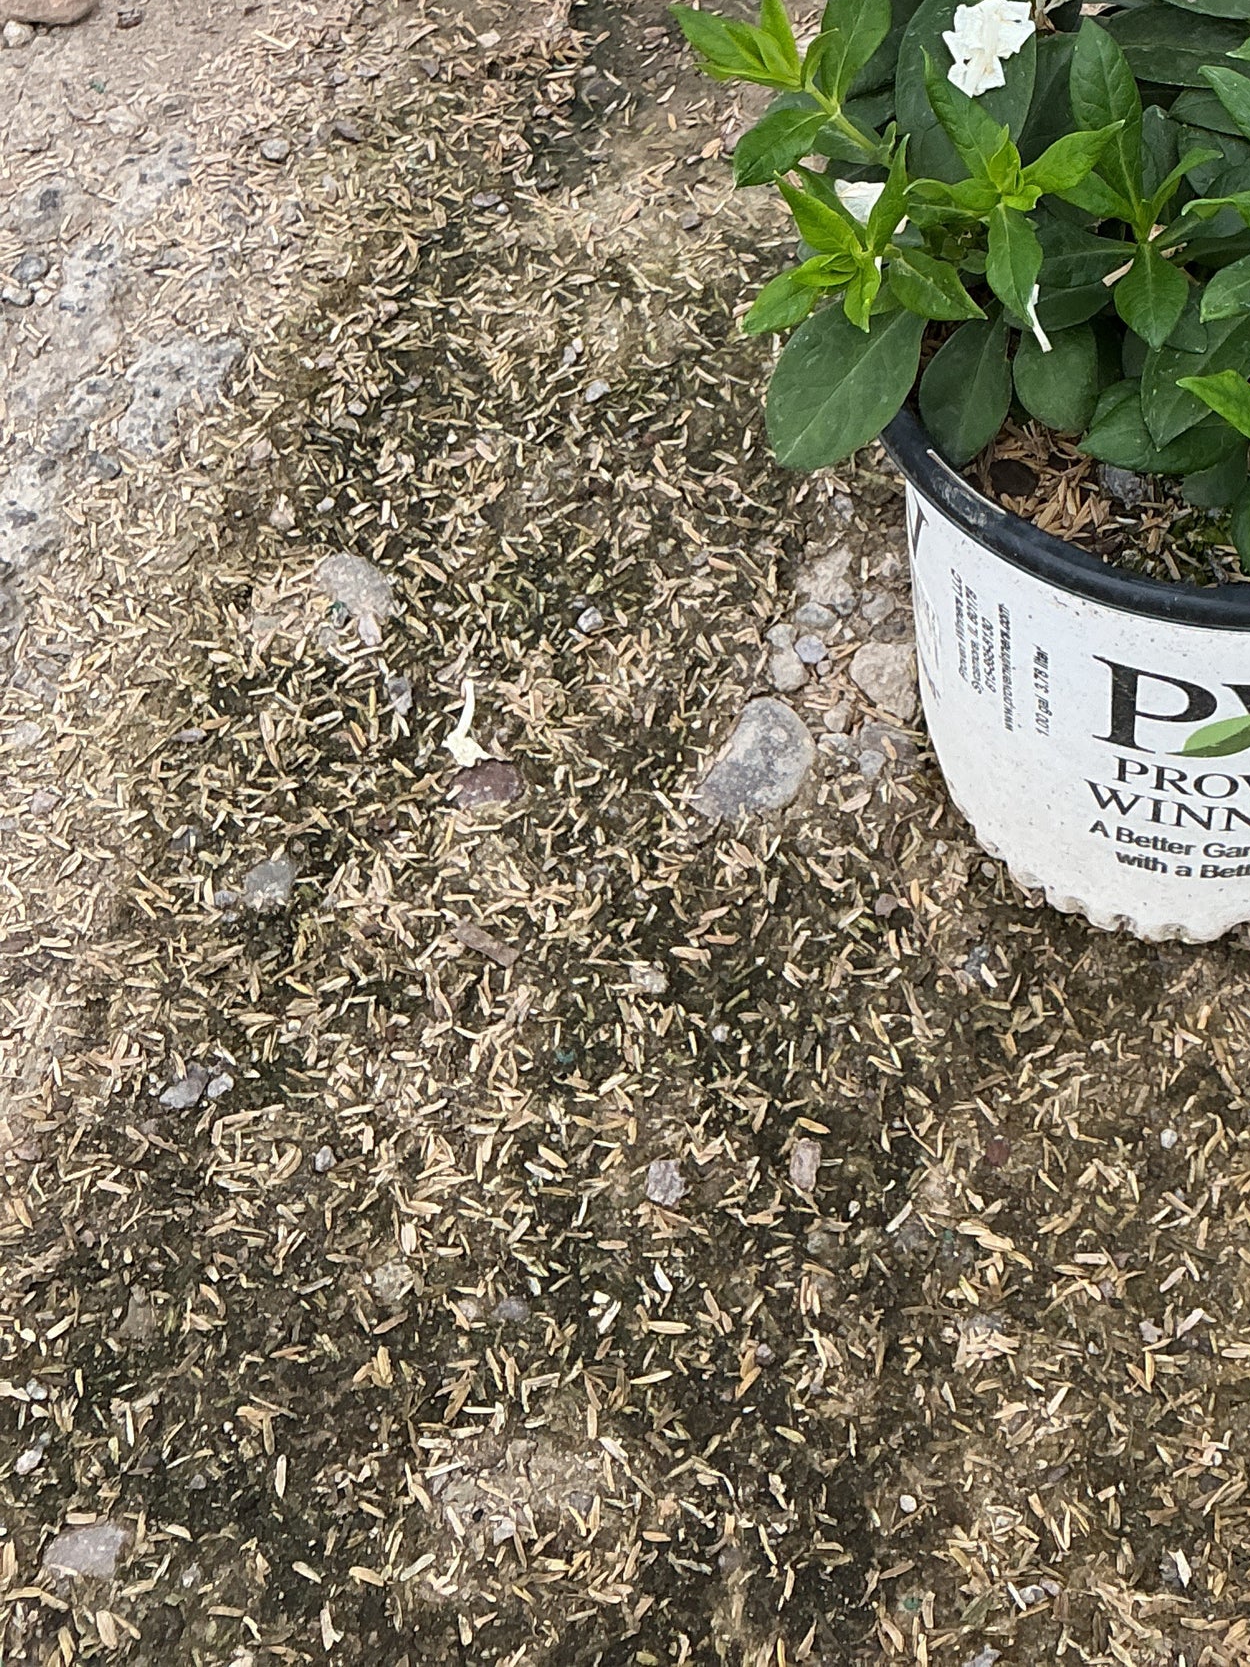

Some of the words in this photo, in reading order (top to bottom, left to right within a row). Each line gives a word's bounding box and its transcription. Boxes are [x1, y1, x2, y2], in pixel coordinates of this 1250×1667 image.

[951, 568, 963, 599] LLC
[955, 597, 967, 644] Winners
[957, 642, 968, 682] Proven
[998, 603, 1015, 733] www.provenwinners.com
[1032, 643, 1050, 671] liter
[1033, 665, 1050, 696] 3.78
[1034, 704, 1051, 737] 1.00
[1089, 820, 1110, 839] A
[1115, 825, 1196, 859] Better
[1114, 850, 1168, 876] with
[1174, 863, 1193, 879] a
